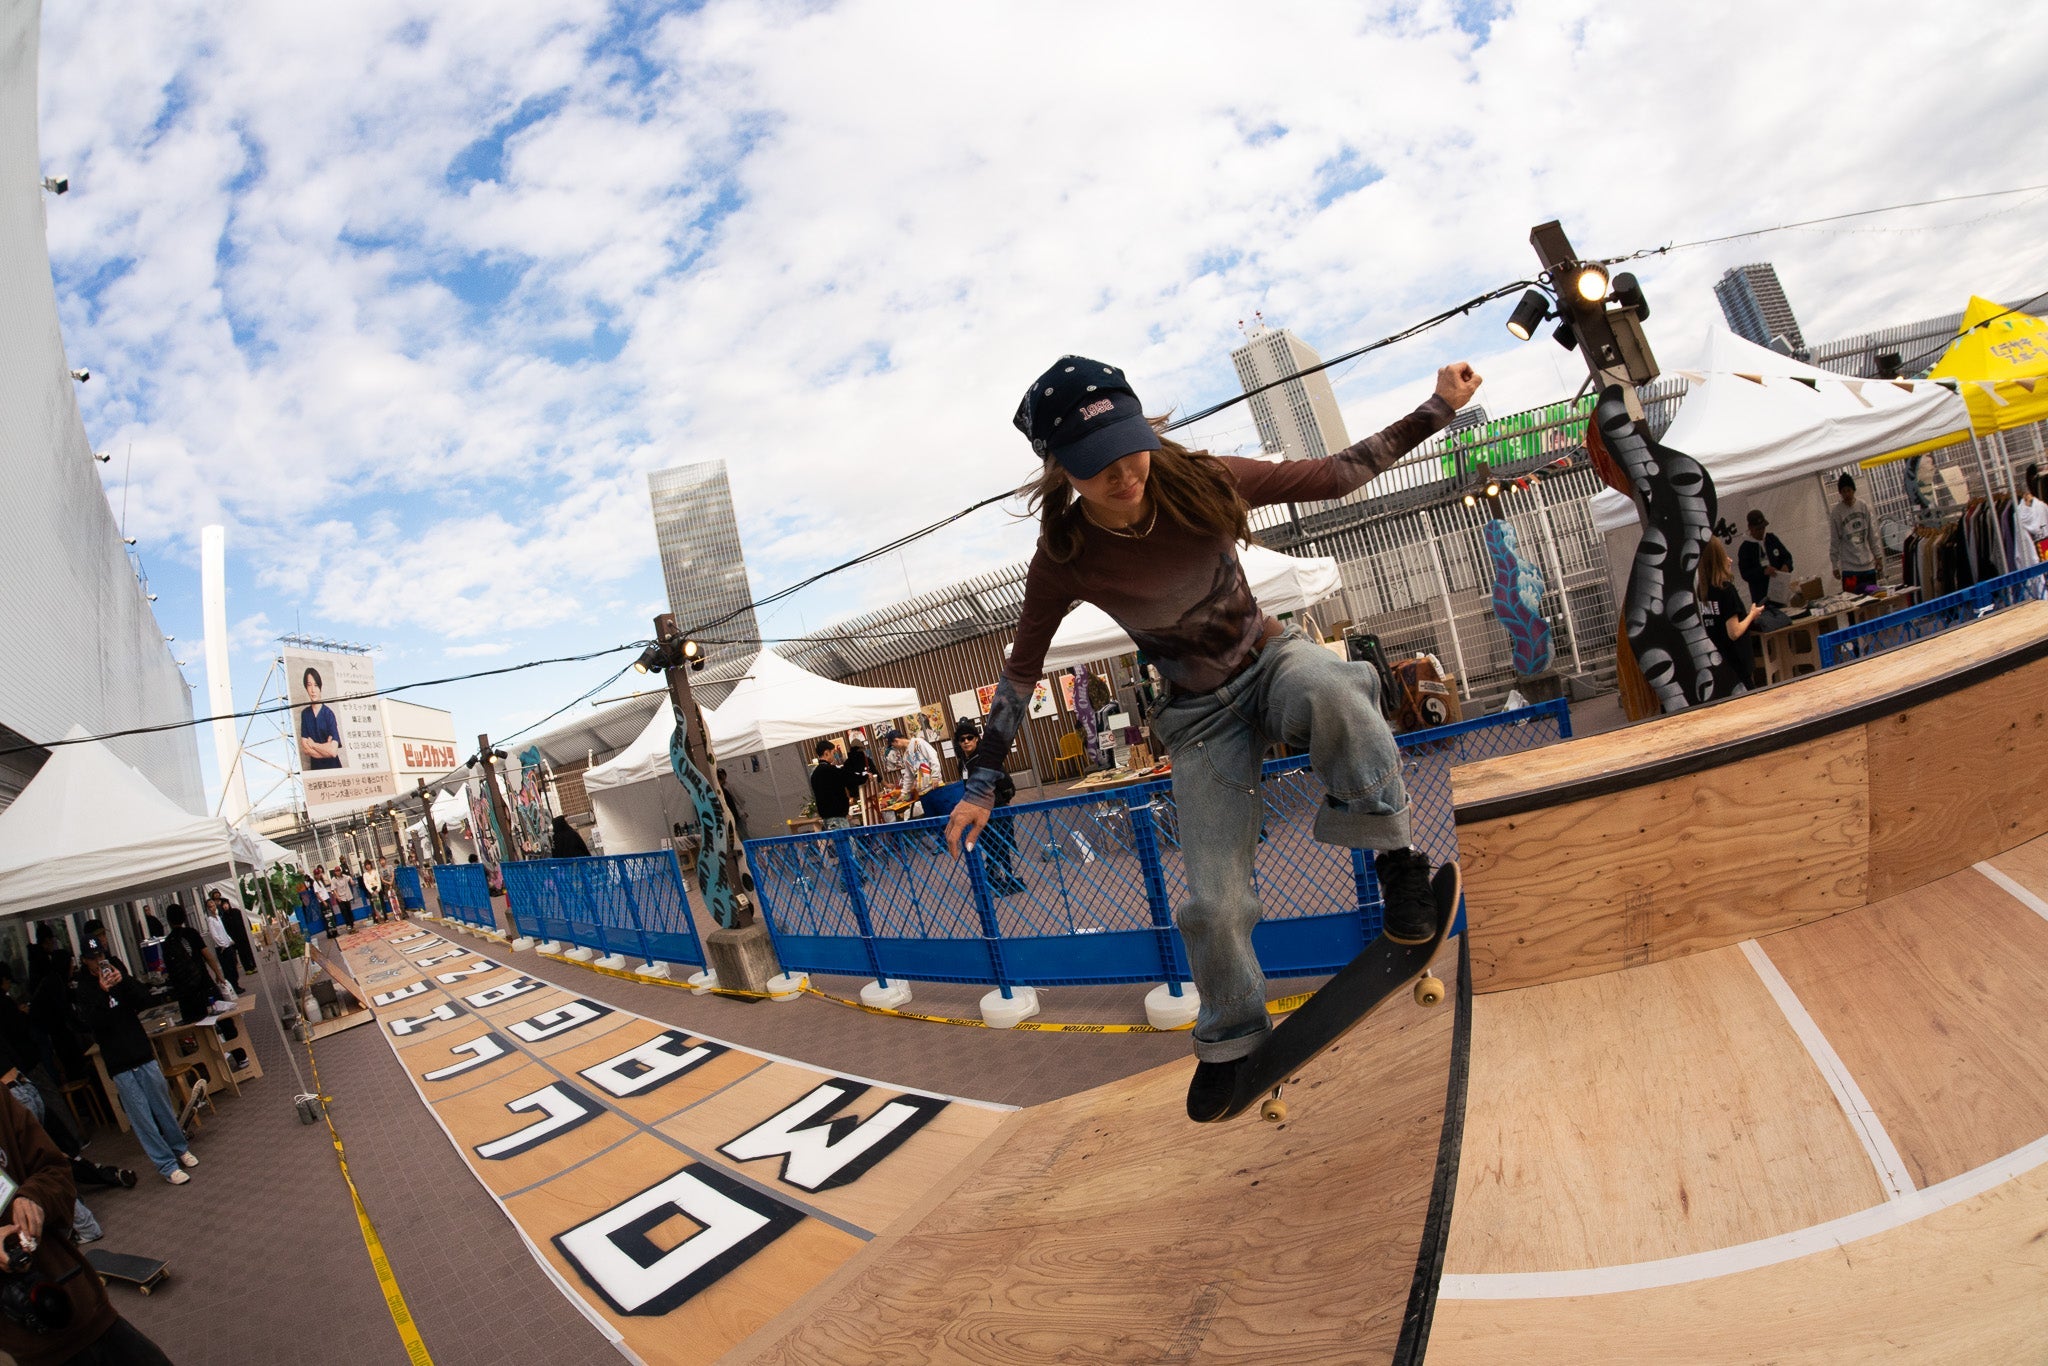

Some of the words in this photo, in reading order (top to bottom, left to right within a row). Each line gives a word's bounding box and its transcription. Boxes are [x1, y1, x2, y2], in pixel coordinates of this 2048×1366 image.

[403, 742, 456, 767] ビックカメラ
[372, 979, 806, 1316] OLLIE
